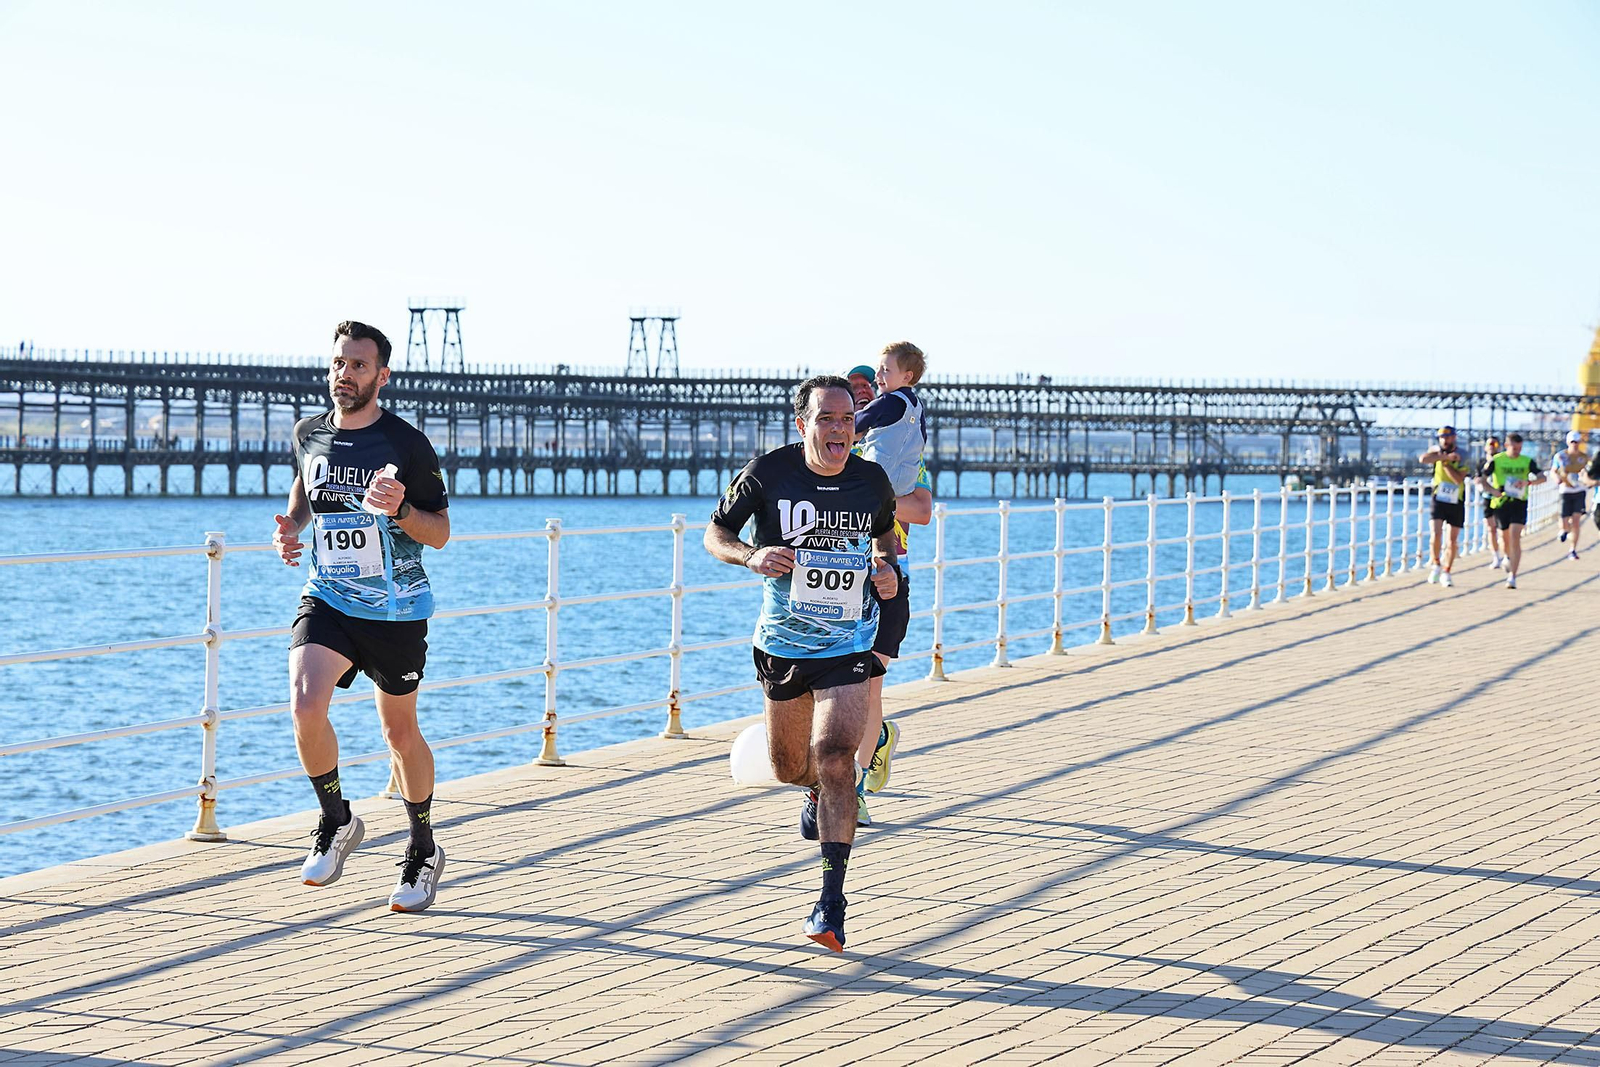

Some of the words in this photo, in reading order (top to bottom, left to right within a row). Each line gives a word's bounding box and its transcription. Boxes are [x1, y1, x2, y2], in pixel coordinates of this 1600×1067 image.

[815, 510, 872, 531] HUELVA
[323, 529, 367, 551] 190
[806, 568, 855, 591] 909
[803, 603, 839, 615] Wayalia
